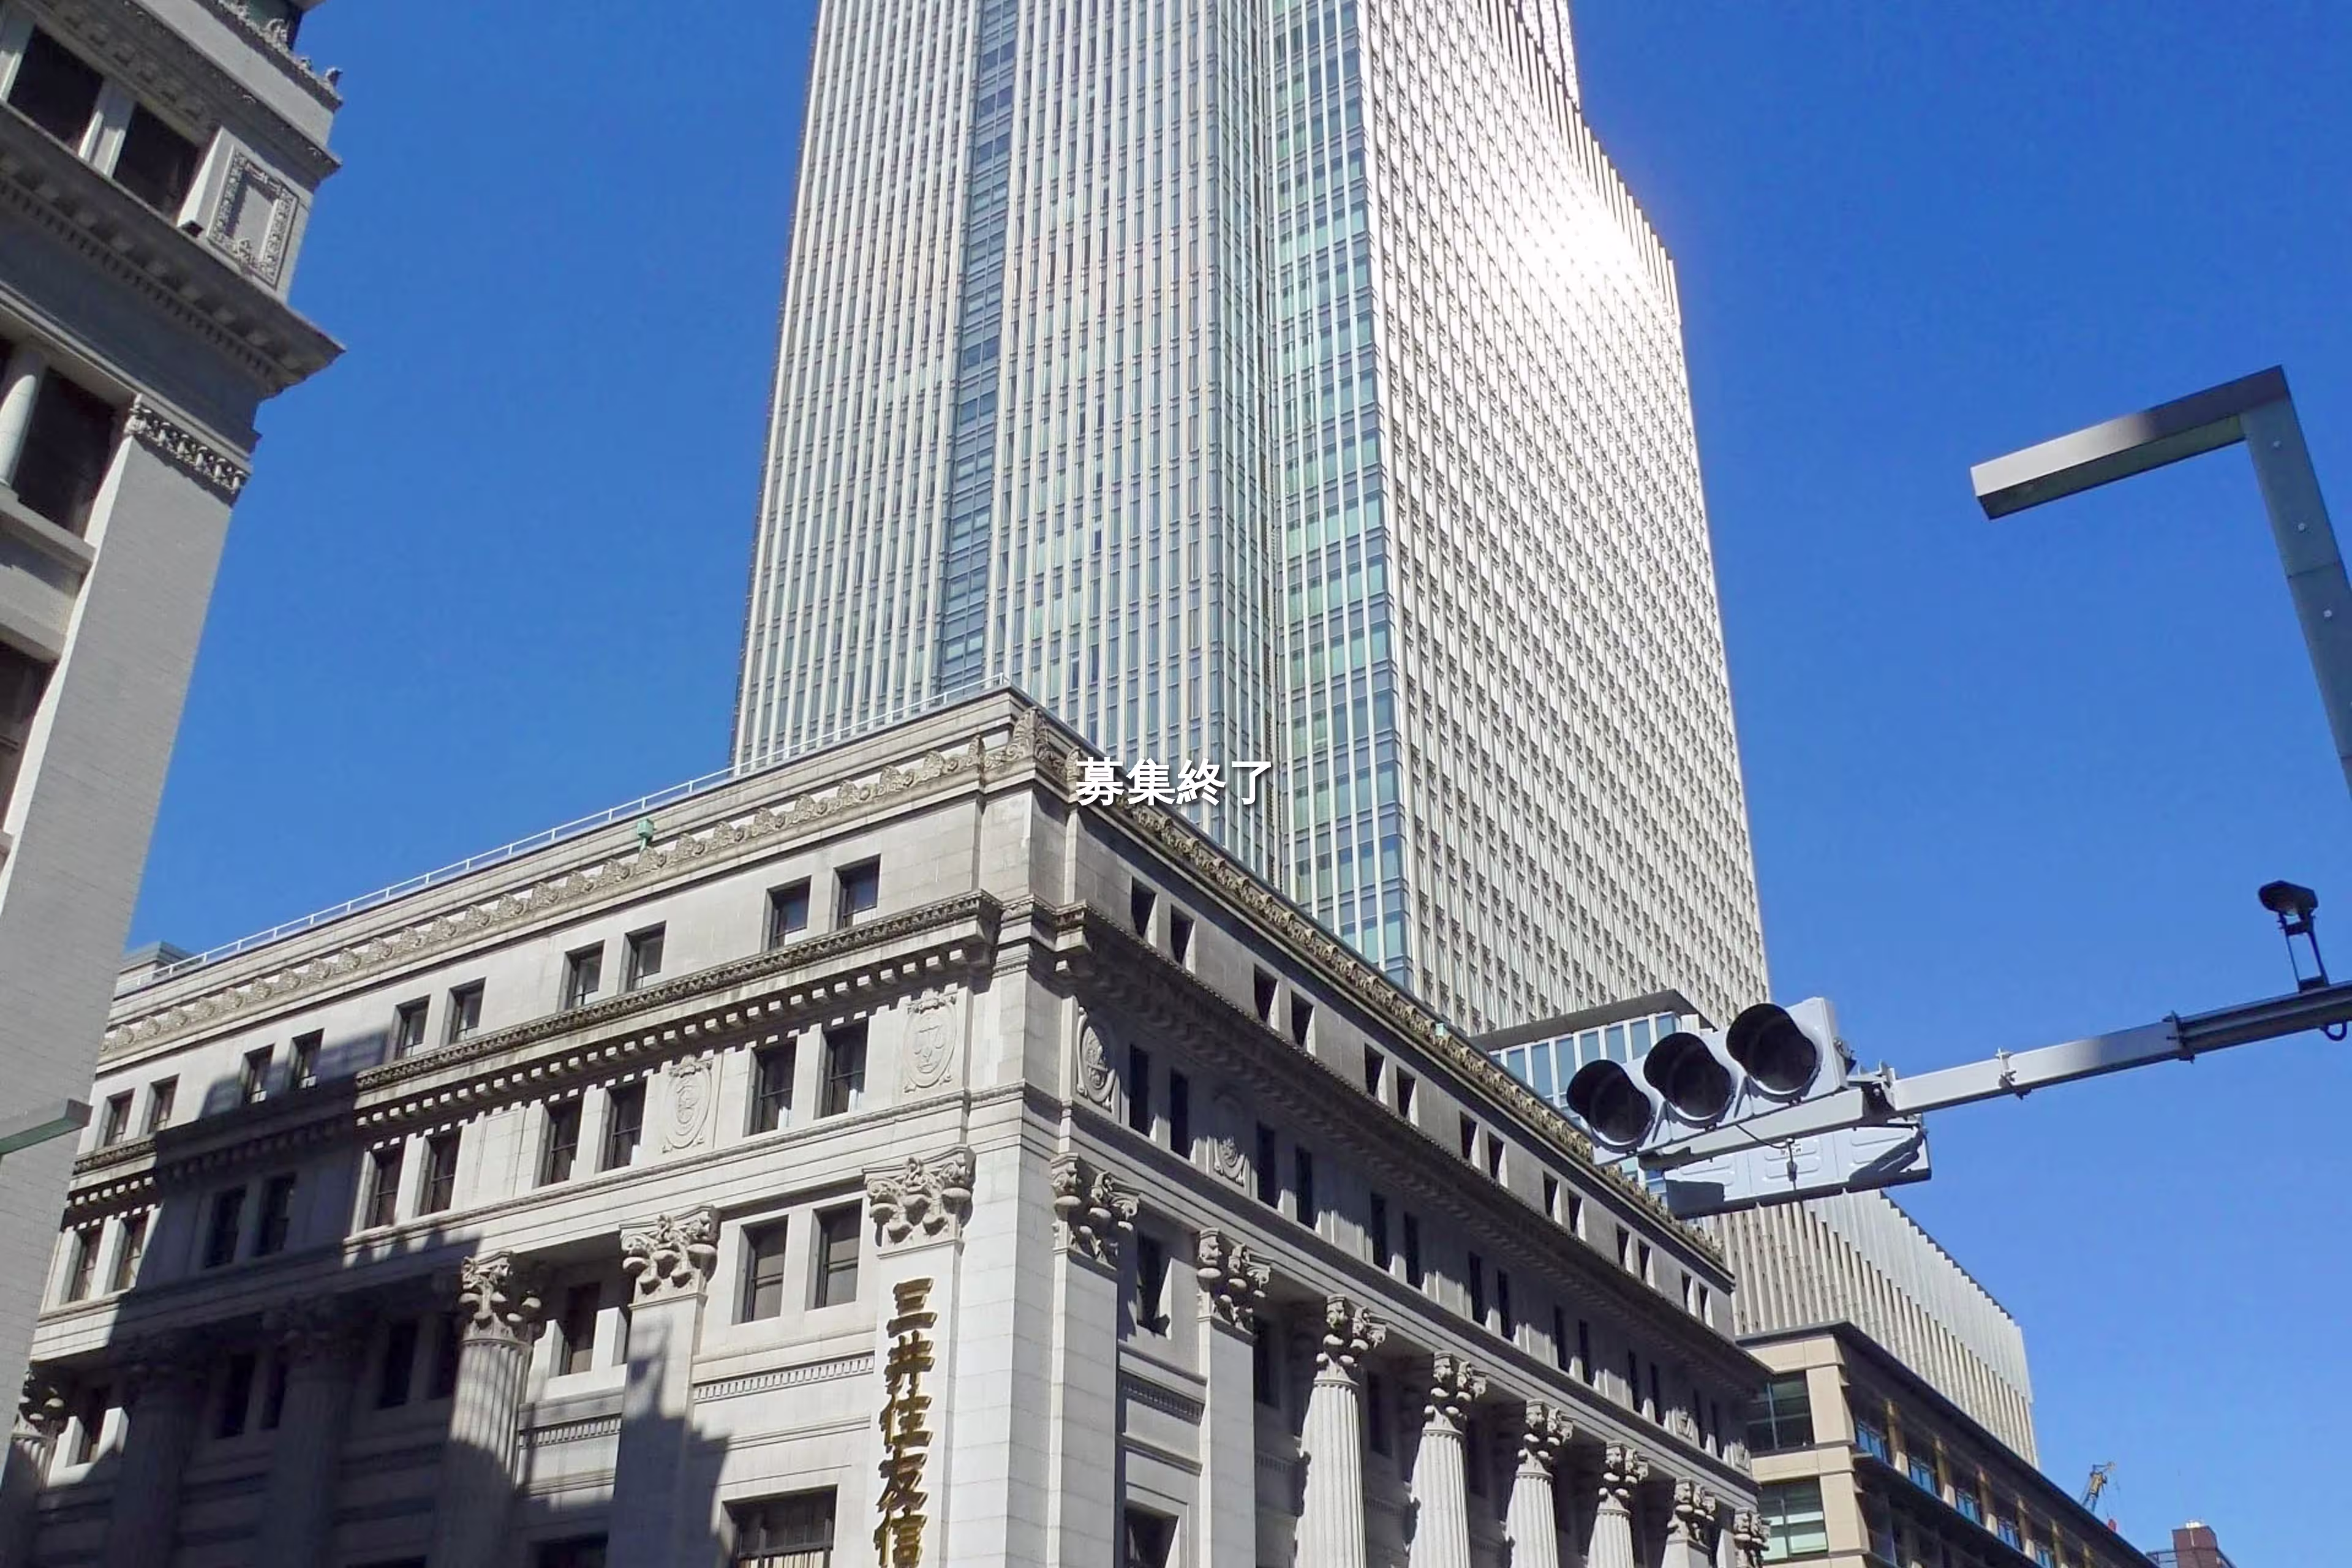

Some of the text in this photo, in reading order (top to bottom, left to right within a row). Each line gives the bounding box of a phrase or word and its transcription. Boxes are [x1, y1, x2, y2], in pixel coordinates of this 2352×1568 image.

[873, 1278, 937, 1568] 三井住友信
